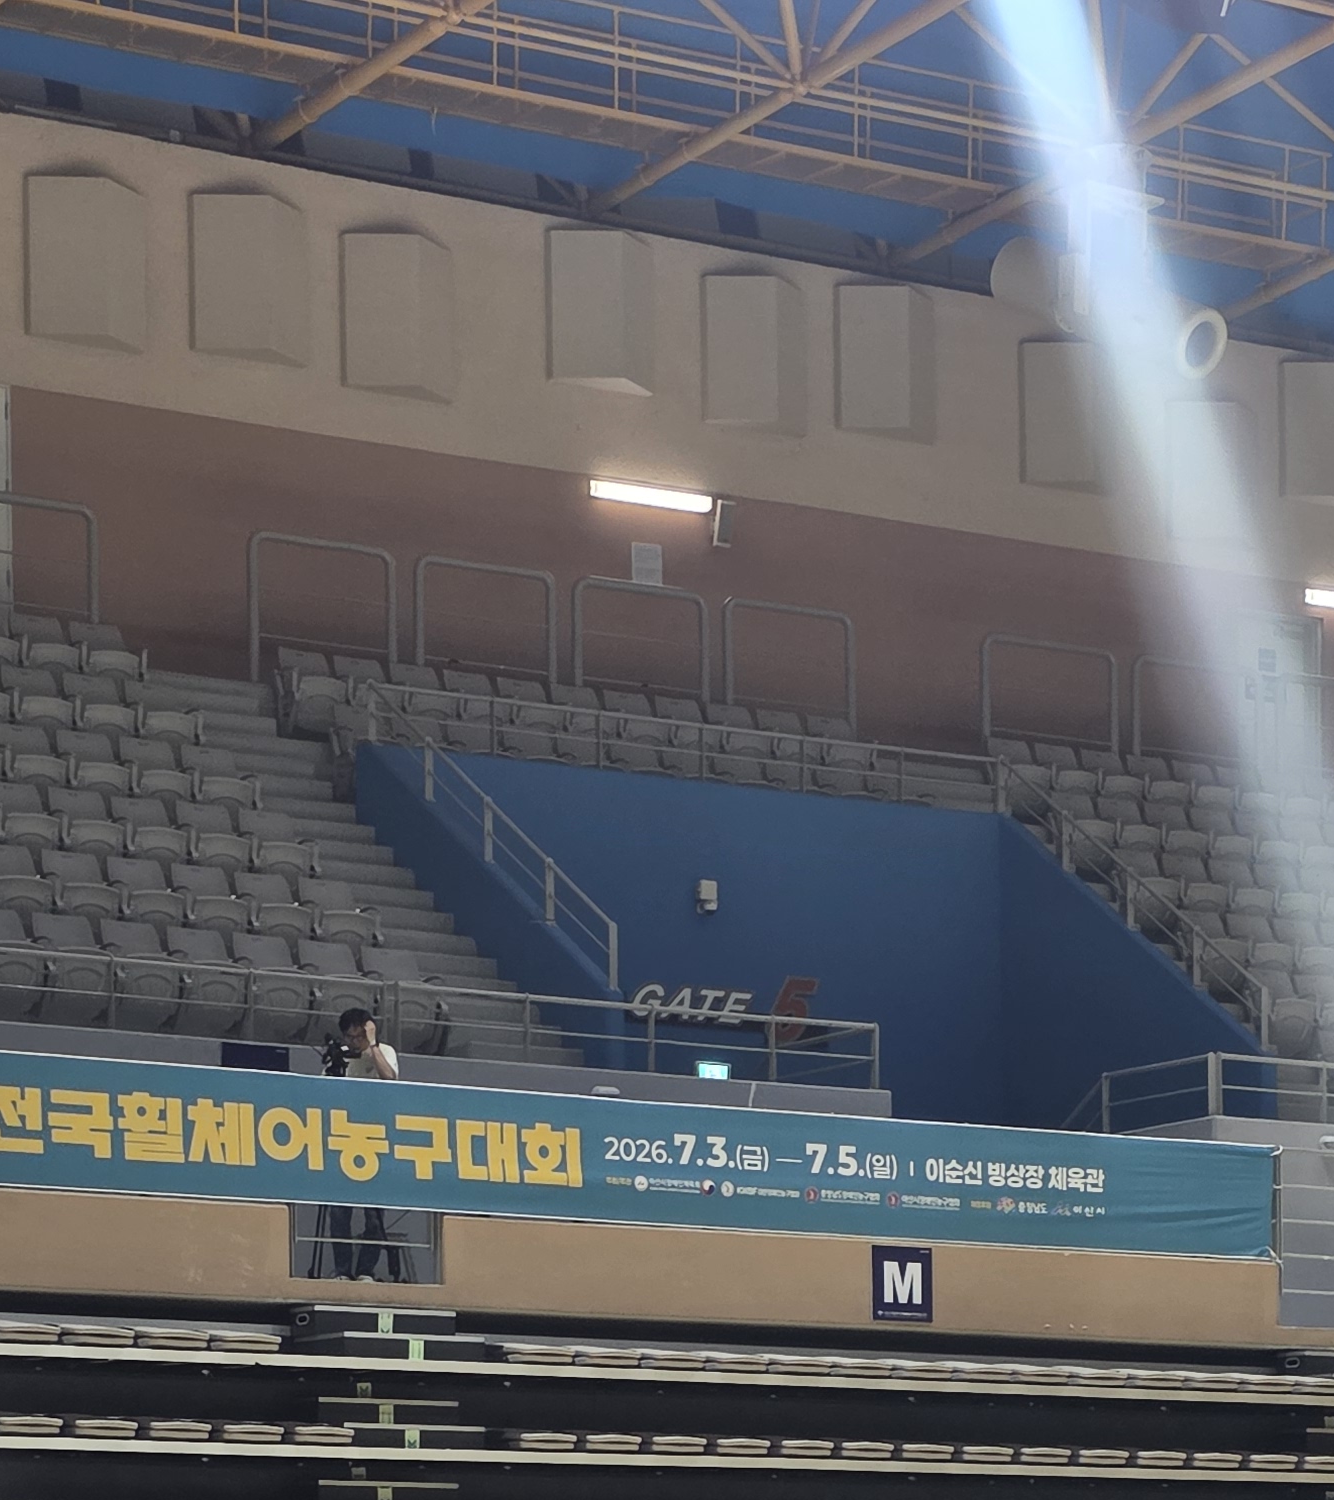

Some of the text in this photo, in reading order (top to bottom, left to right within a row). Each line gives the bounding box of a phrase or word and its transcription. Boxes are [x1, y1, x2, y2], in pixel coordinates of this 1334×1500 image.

[631, 983, 753, 1024] GATE
[925, 1158, 982, 1185] 이순신
[987, 1162, 1045, 1188] 빙상장
[1048, 1167, 1105, 1192] 체육관
[883, 1261, 922, 1305] M
